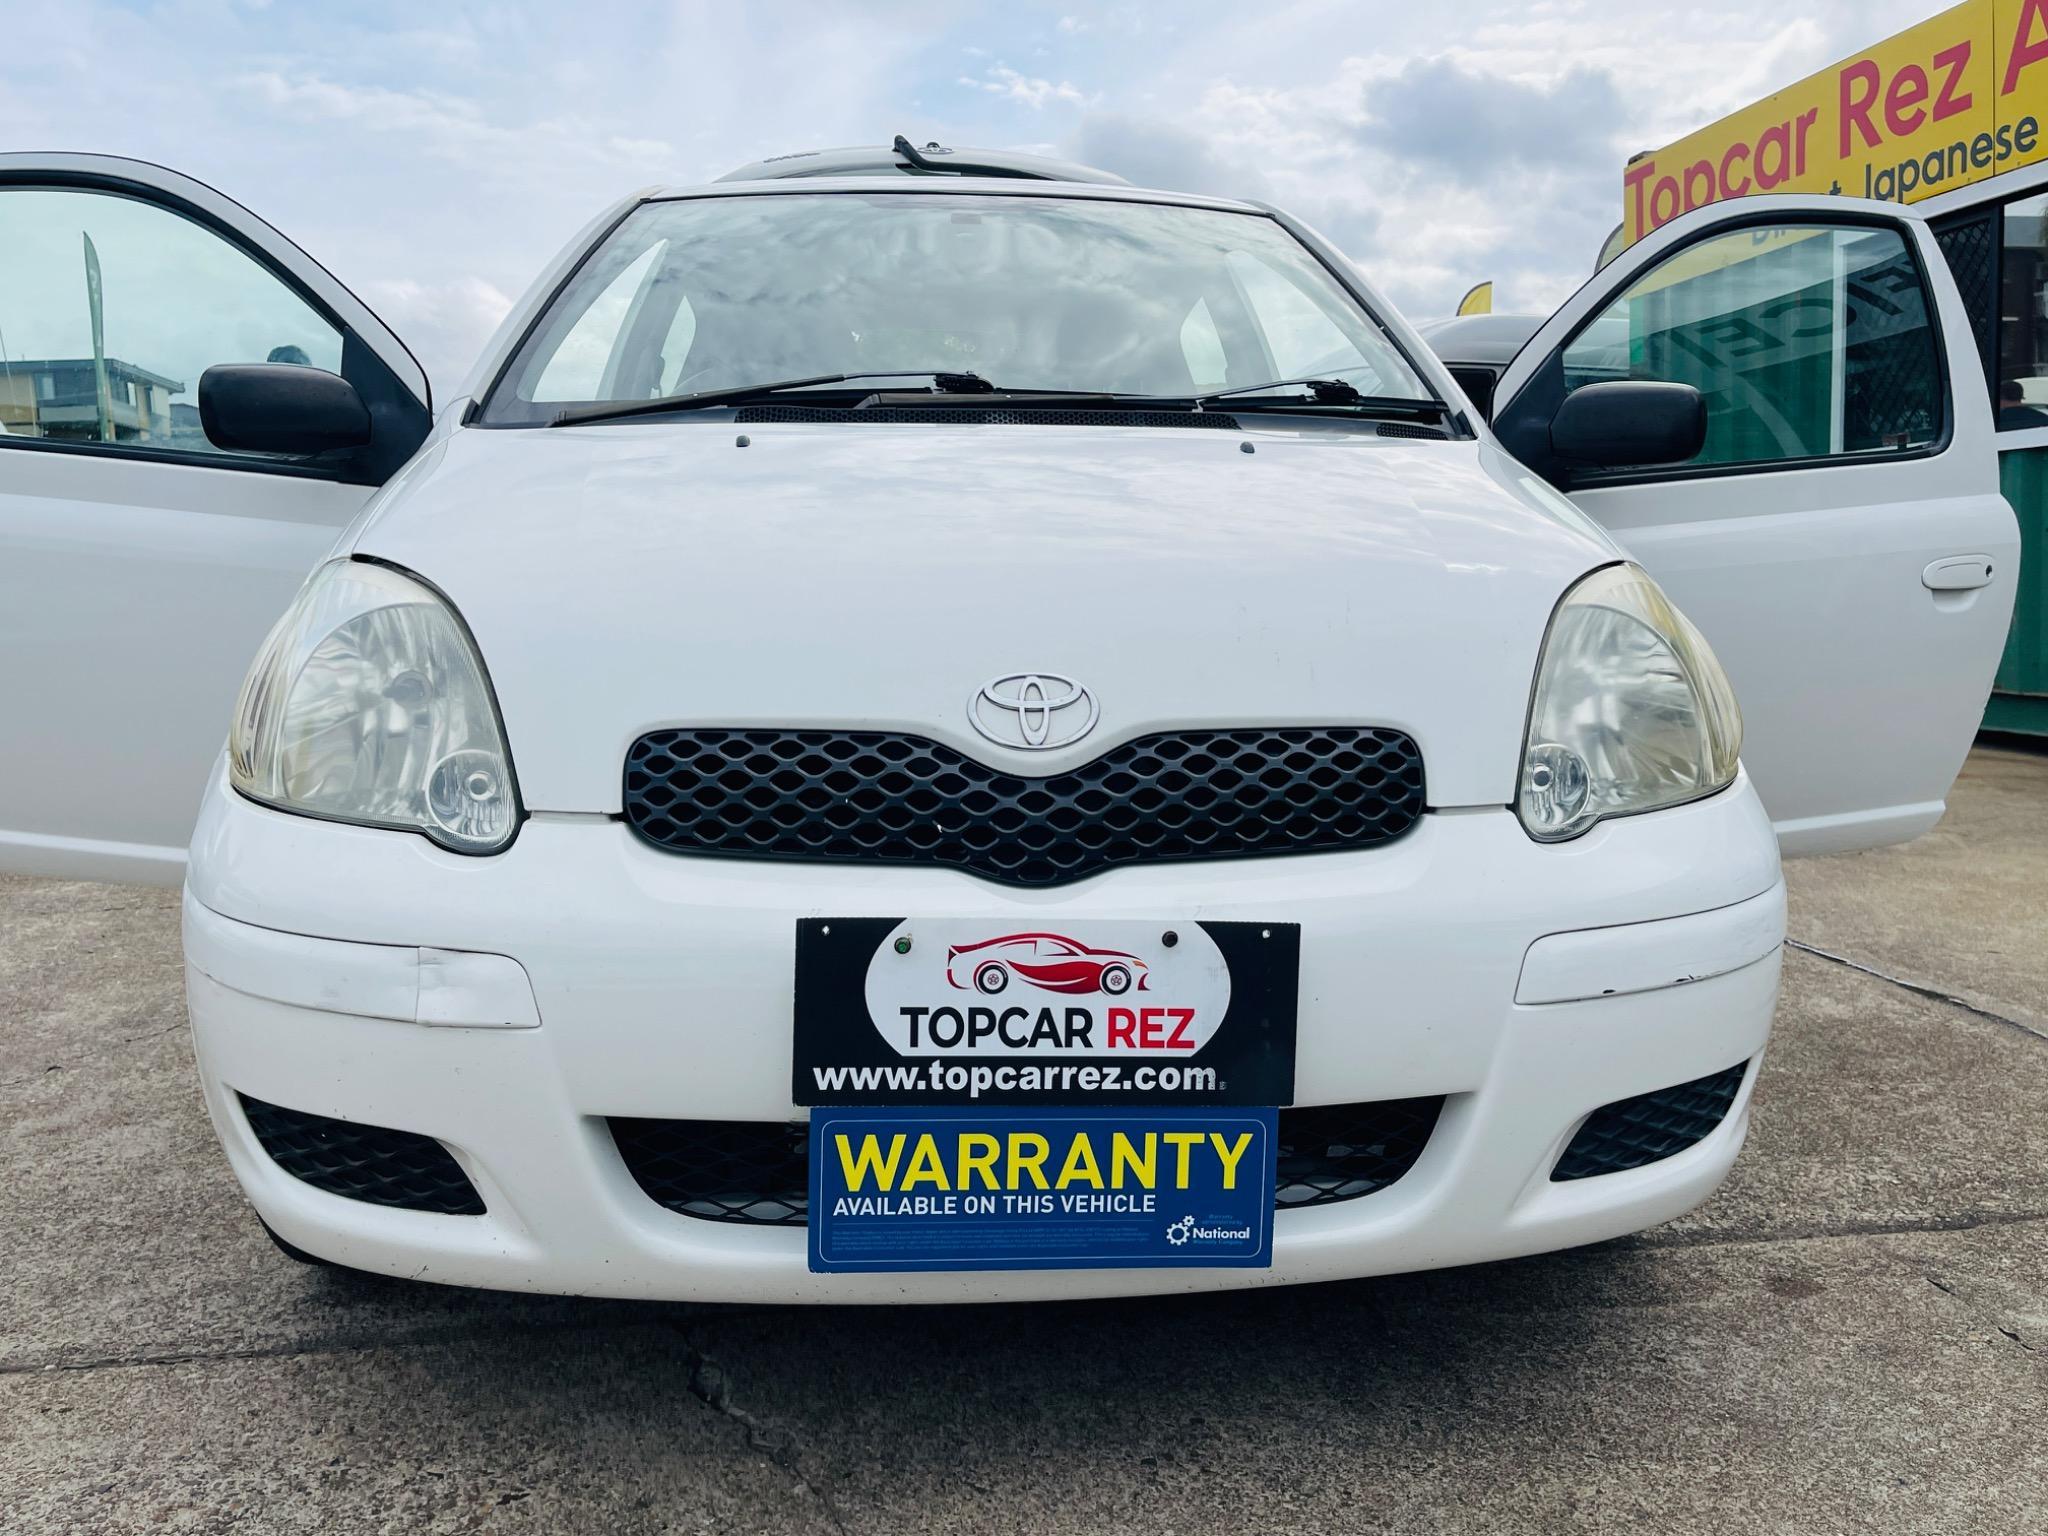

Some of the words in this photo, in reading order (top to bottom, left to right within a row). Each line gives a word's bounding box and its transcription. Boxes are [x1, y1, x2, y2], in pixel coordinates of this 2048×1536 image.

[1624, 107, 1818, 240] Topcar
[1840, 40, 1972, 160] Rez
[1866, 116, 2039, 203] Japanese
[900, 1006, 1093, 1049] TOPCAR
[1107, 1007, 1196, 1049] REZ
[835, 1133, 1253, 1192] WARRANTY
[833, 1196, 957, 1216] AVAILABLE
[965, 1196, 996, 1214] ON
[1002, 1195, 1054, 1214] THIS
[1061, 1194, 1156, 1213] VEHICLE
[1192, 1226, 1250, 1239] National
